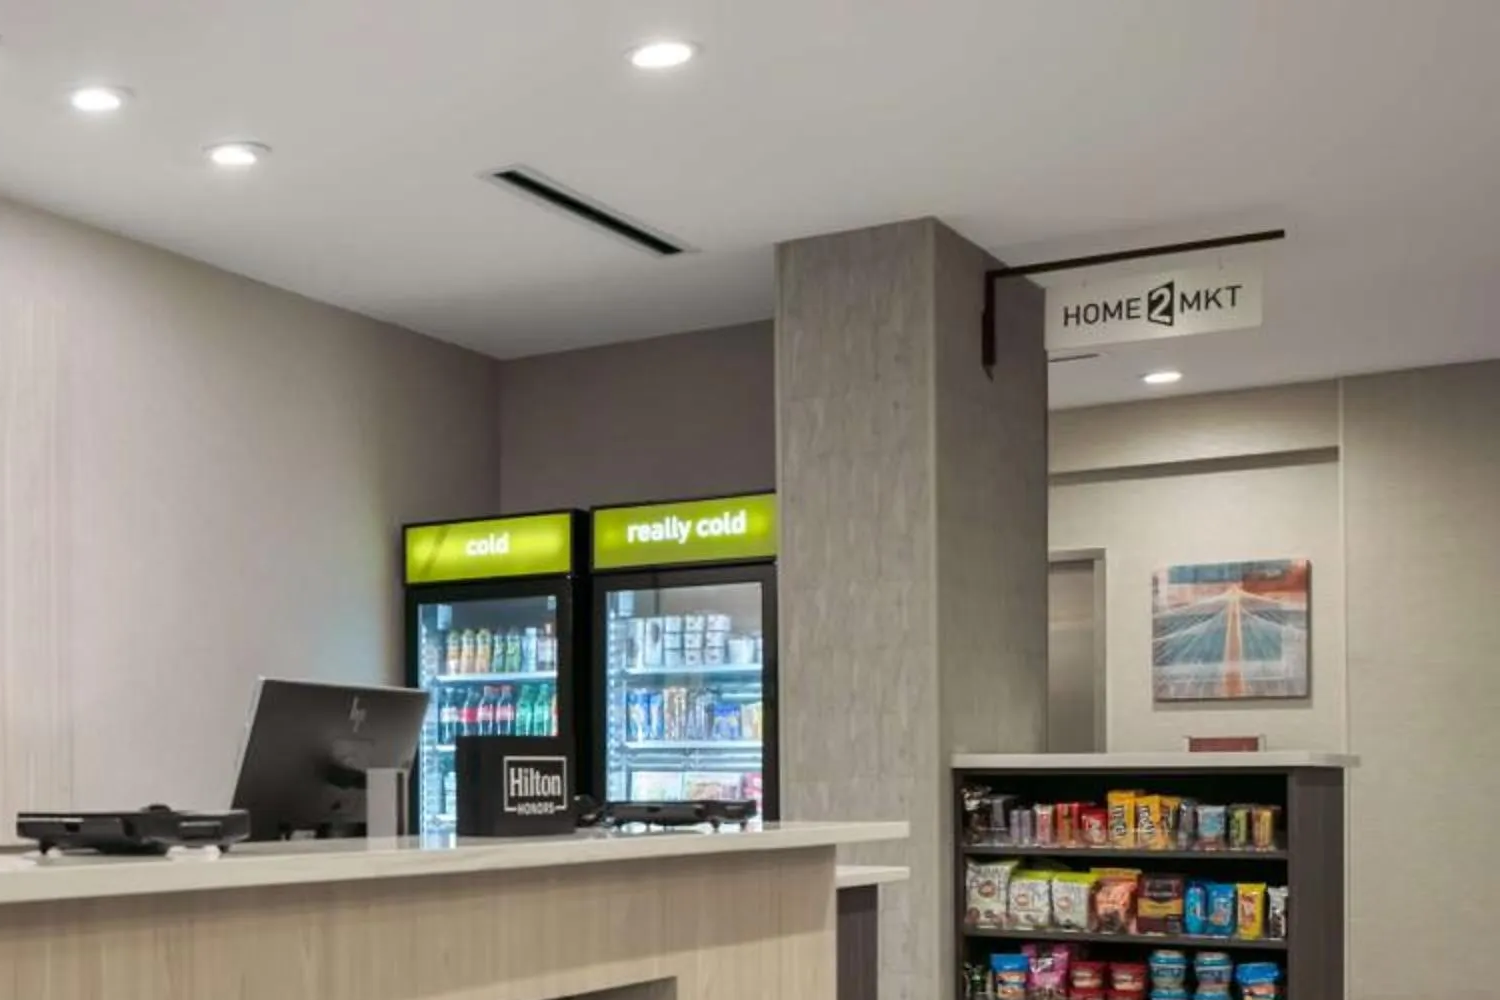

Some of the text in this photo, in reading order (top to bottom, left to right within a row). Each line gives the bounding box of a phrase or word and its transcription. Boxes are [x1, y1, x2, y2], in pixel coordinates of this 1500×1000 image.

[627, 509, 746, 544] really cold
[465, 532, 510, 557] cold
[509, 767, 562, 798] Hilton
